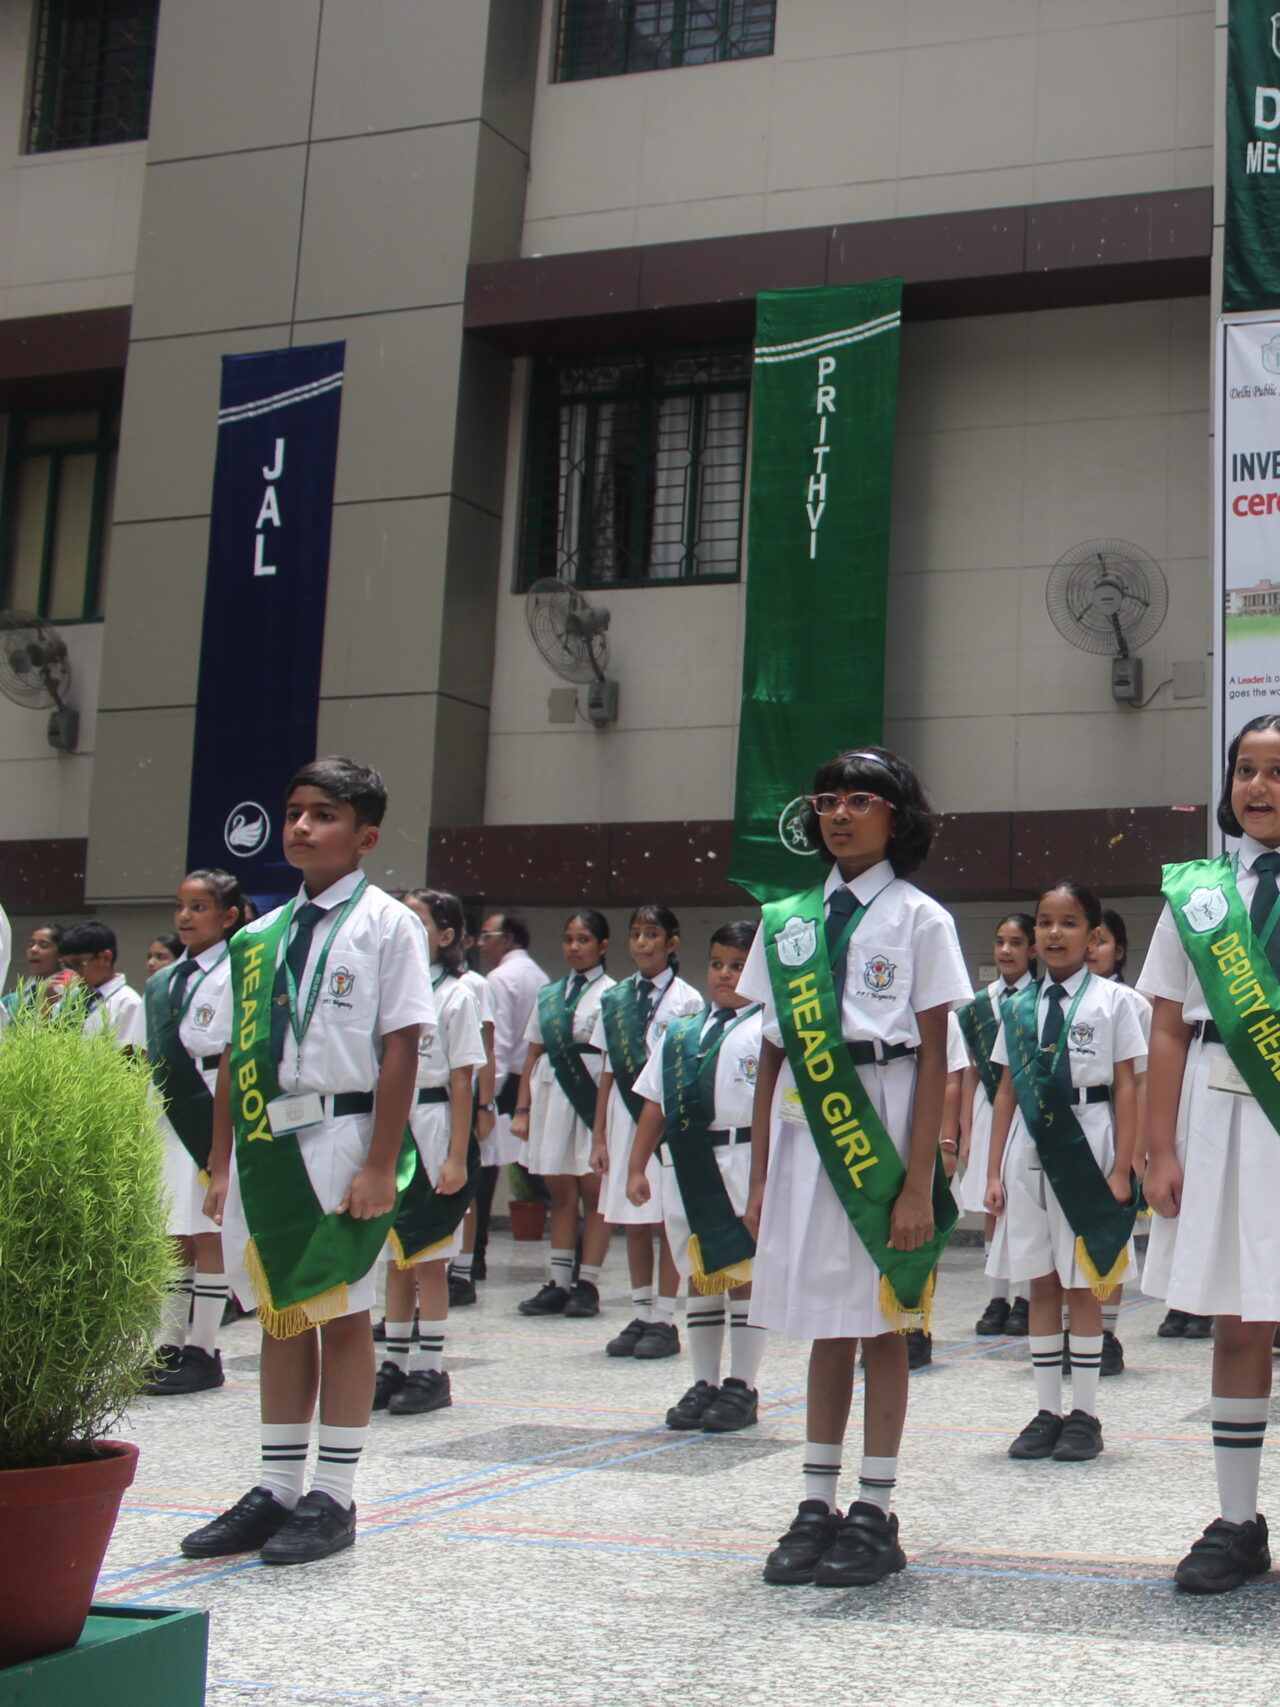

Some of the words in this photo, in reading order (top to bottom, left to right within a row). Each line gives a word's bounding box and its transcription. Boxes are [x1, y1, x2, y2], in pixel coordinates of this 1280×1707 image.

[1230, 385, 1251, 399] Delhi
[1252, 382, 1276, 397] Public
[806, 356, 836, 559] PRITHVI
[254, 438, 285, 576] JAL
[1229, 677, 1236, 685] A
[1238, 676, 1264, 685] Leader
[1265, 675, 1272, 683] is
[1229, 690, 1250, 699] goes
[1253, 688, 1267, 696] the
[239, 942, 265, 1052] HEAD
[1210, 932, 1271, 1018] DEPUTY
[238, 1058, 274, 1143] BOY
[788, 972, 835, 1083] HEAD
[821, 1091, 879, 1189] GIRL
